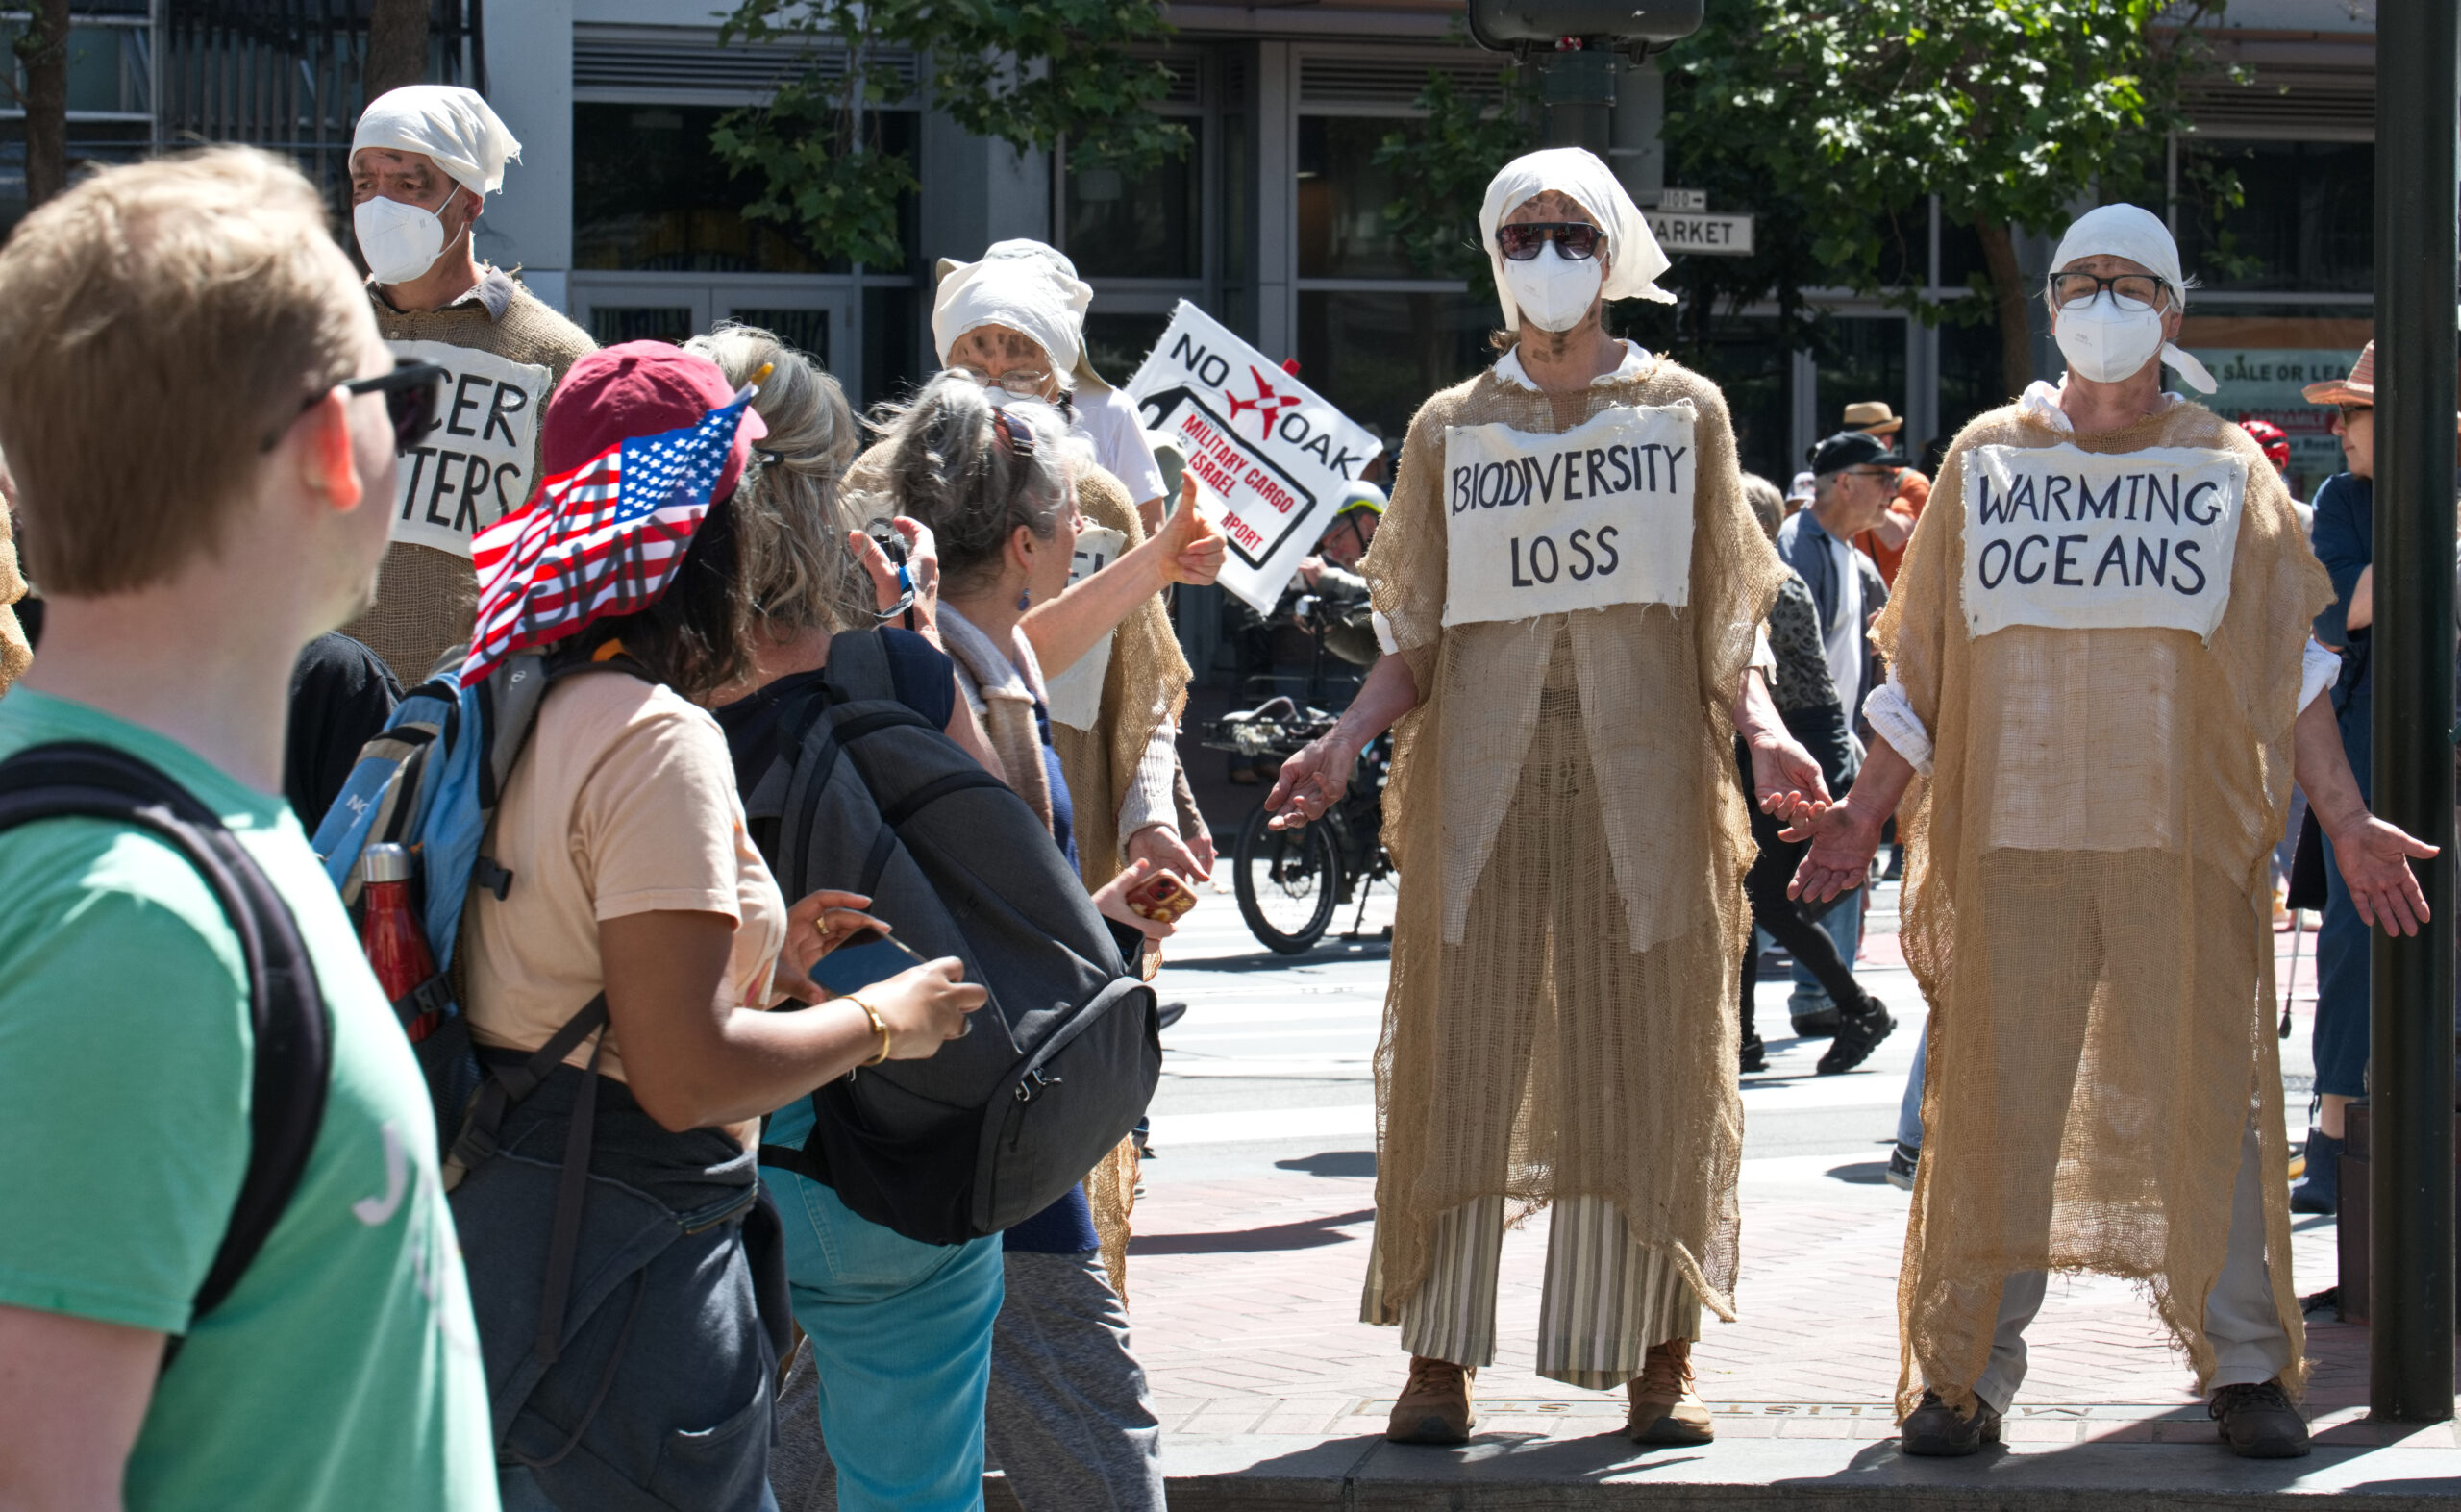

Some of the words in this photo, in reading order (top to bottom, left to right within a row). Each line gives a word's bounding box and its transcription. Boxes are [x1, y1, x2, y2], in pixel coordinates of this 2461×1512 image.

[1647, 219, 1733, 244] ARKET
[2224, 364, 2273, 382] SALE
[2276, 364, 2304, 382] OR
[1170, 333, 1230, 388] NO
[1279, 412, 1364, 481] OAK
[1181, 413, 1249, 474] MILITARY
[1244, 468, 1295, 514] CARGO
[1188, 450, 1237, 499] ISRAEL
[1452, 443, 1687, 516] BIODIVERSITY
[1979, 473, 2222, 526] WARMING
[1511, 525, 1619, 587] LOSS
[1979, 534, 2206, 595] OCEANS
